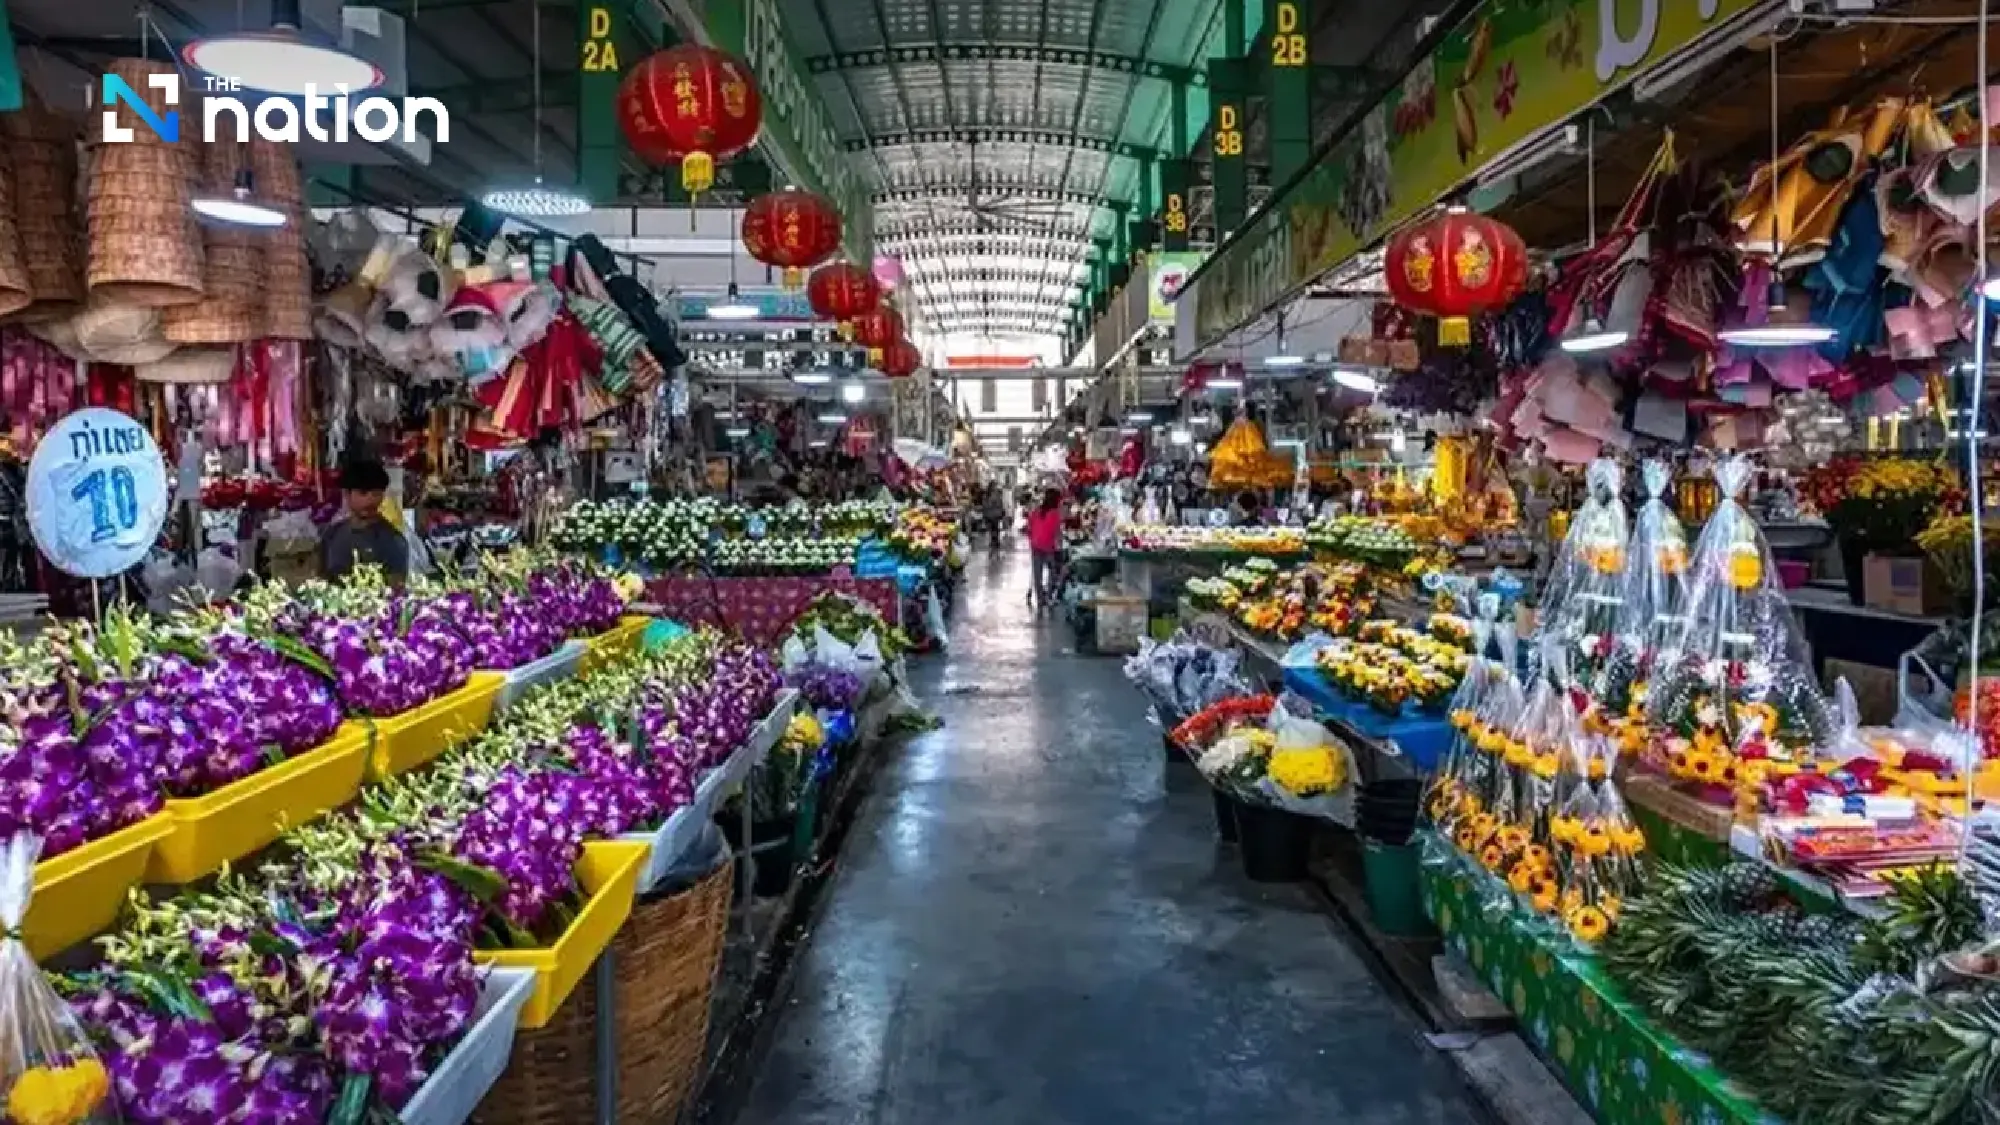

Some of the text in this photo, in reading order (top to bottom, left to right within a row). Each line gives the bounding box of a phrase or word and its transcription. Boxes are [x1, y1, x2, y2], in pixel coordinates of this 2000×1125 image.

[591, 8, 611, 38] D
[1277, 3, 1298, 33] D
[583, 40, 619, 71] 2A
[1272, 34, 1306, 66] 2B
[1222, 105, 1236, 129] D
[1214, 131, 1243, 155] 3B
[71, 465, 138, 543] 10
